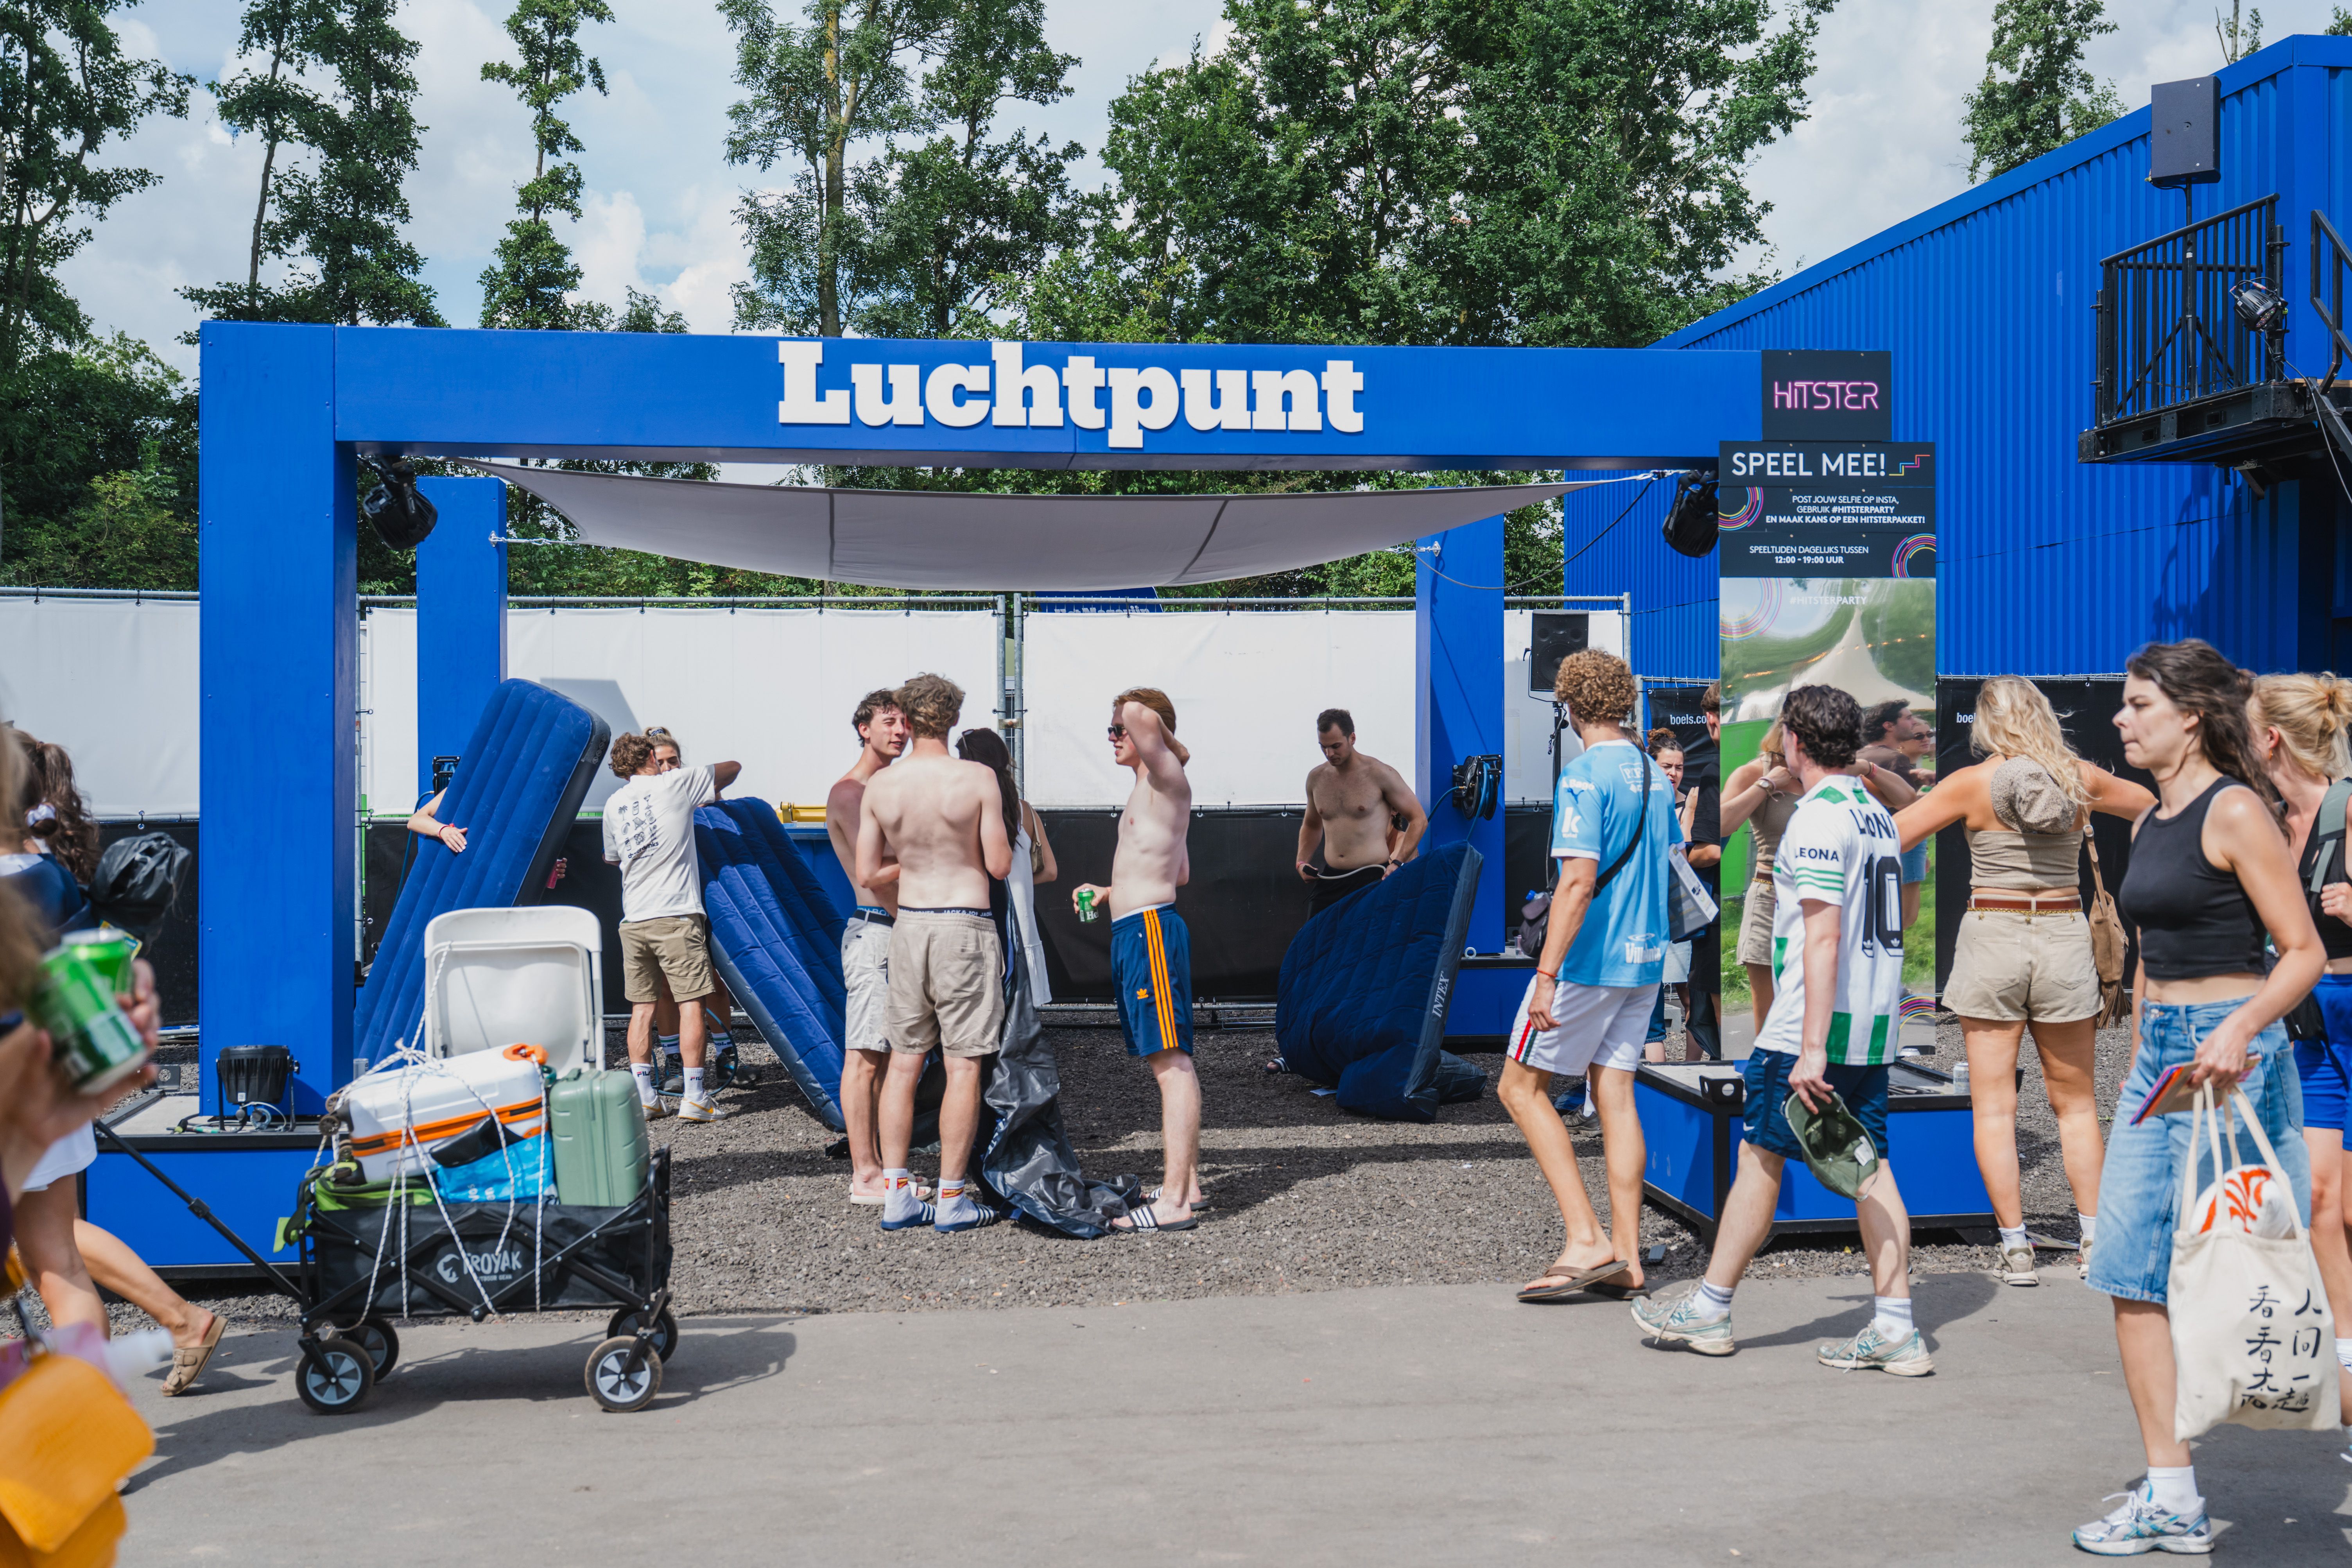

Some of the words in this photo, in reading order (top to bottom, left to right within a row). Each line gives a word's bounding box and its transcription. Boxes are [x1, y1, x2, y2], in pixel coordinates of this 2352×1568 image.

[778, 341, 1364, 448] Luchtpunt
[1774, 381, 1879, 409] HITSTER
[1732, 452, 1813, 476] SPEEL
[1822, 453, 1886, 477] MEE!
[1876, 496, 1899, 504] INSTA,
[1789, 597, 1867, 605] #HITSTERPARTY
[1670, 714, 1707, 725] boels.co
[1956, 712, 1976, 723] boel
[1795, 847, 1839, 862] EONA
[1862, 853, 1904, 958] 10
[1432, 973, 1449, 1019] INTEX
